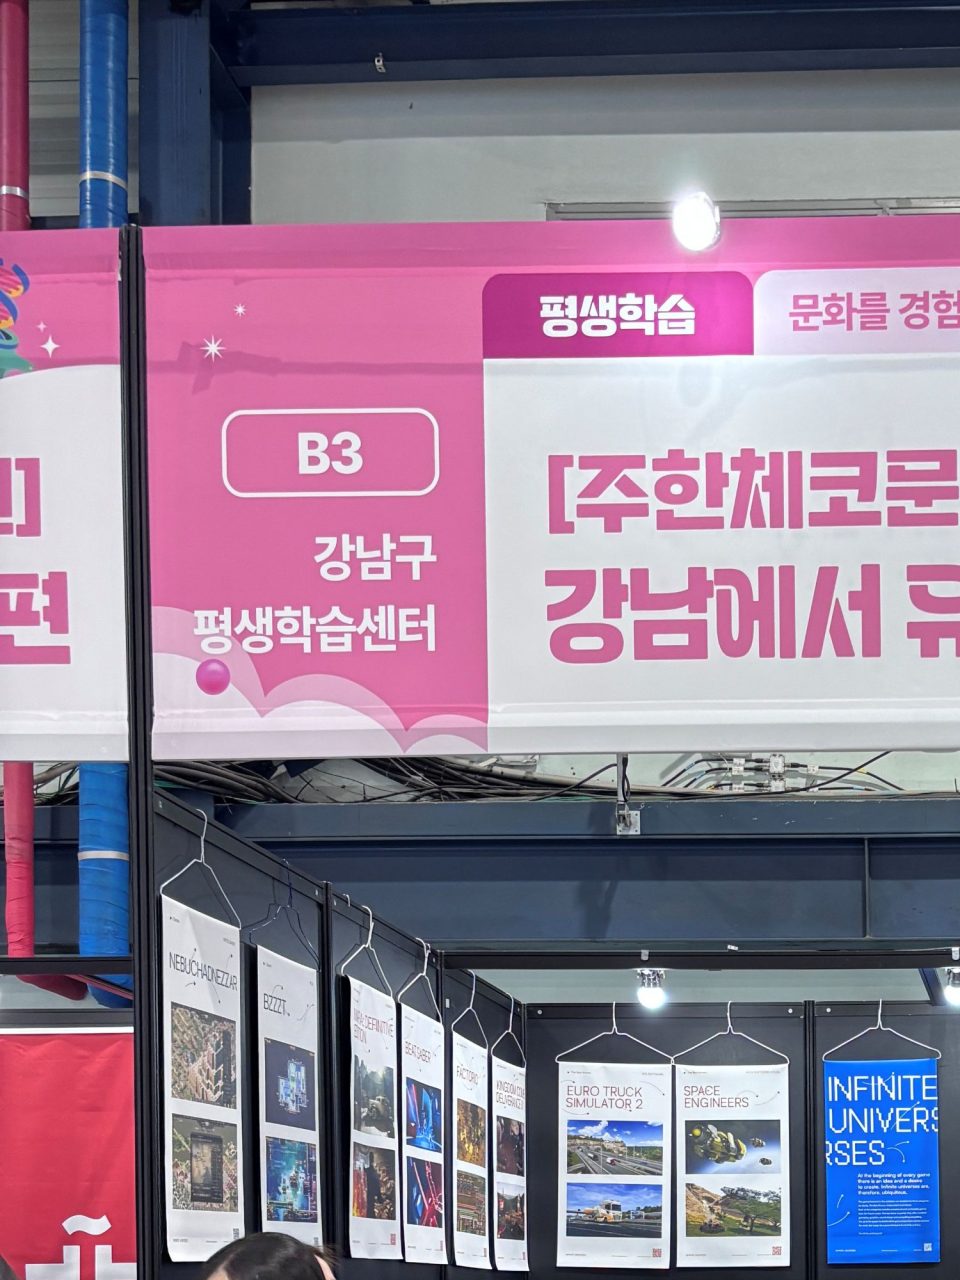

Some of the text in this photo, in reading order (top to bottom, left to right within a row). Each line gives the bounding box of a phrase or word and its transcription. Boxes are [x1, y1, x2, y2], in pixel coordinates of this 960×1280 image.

[539, 292, 696, 337] 평생학습
[788, 291, 890, 332] 문화를
[297, 432, 364, 476] B3
[313, 534, 438, 583] 강남구
[193, 604, 437, 655] 평생학습센터
[546, 563, 882, 665] 강남에서
[169, 951, 238, 991] NEBUCHADNEZZAR
[566, 1097, 643, 1109] SIMULATOR 2
[567, 1085, 643, 1097] EURO TRUCK
[683, 1085, 720, 1096] SPACE
[684, 1097, 749, 1108] ENGINEERS
[828, 1074, 938, 1101] INFINITE
